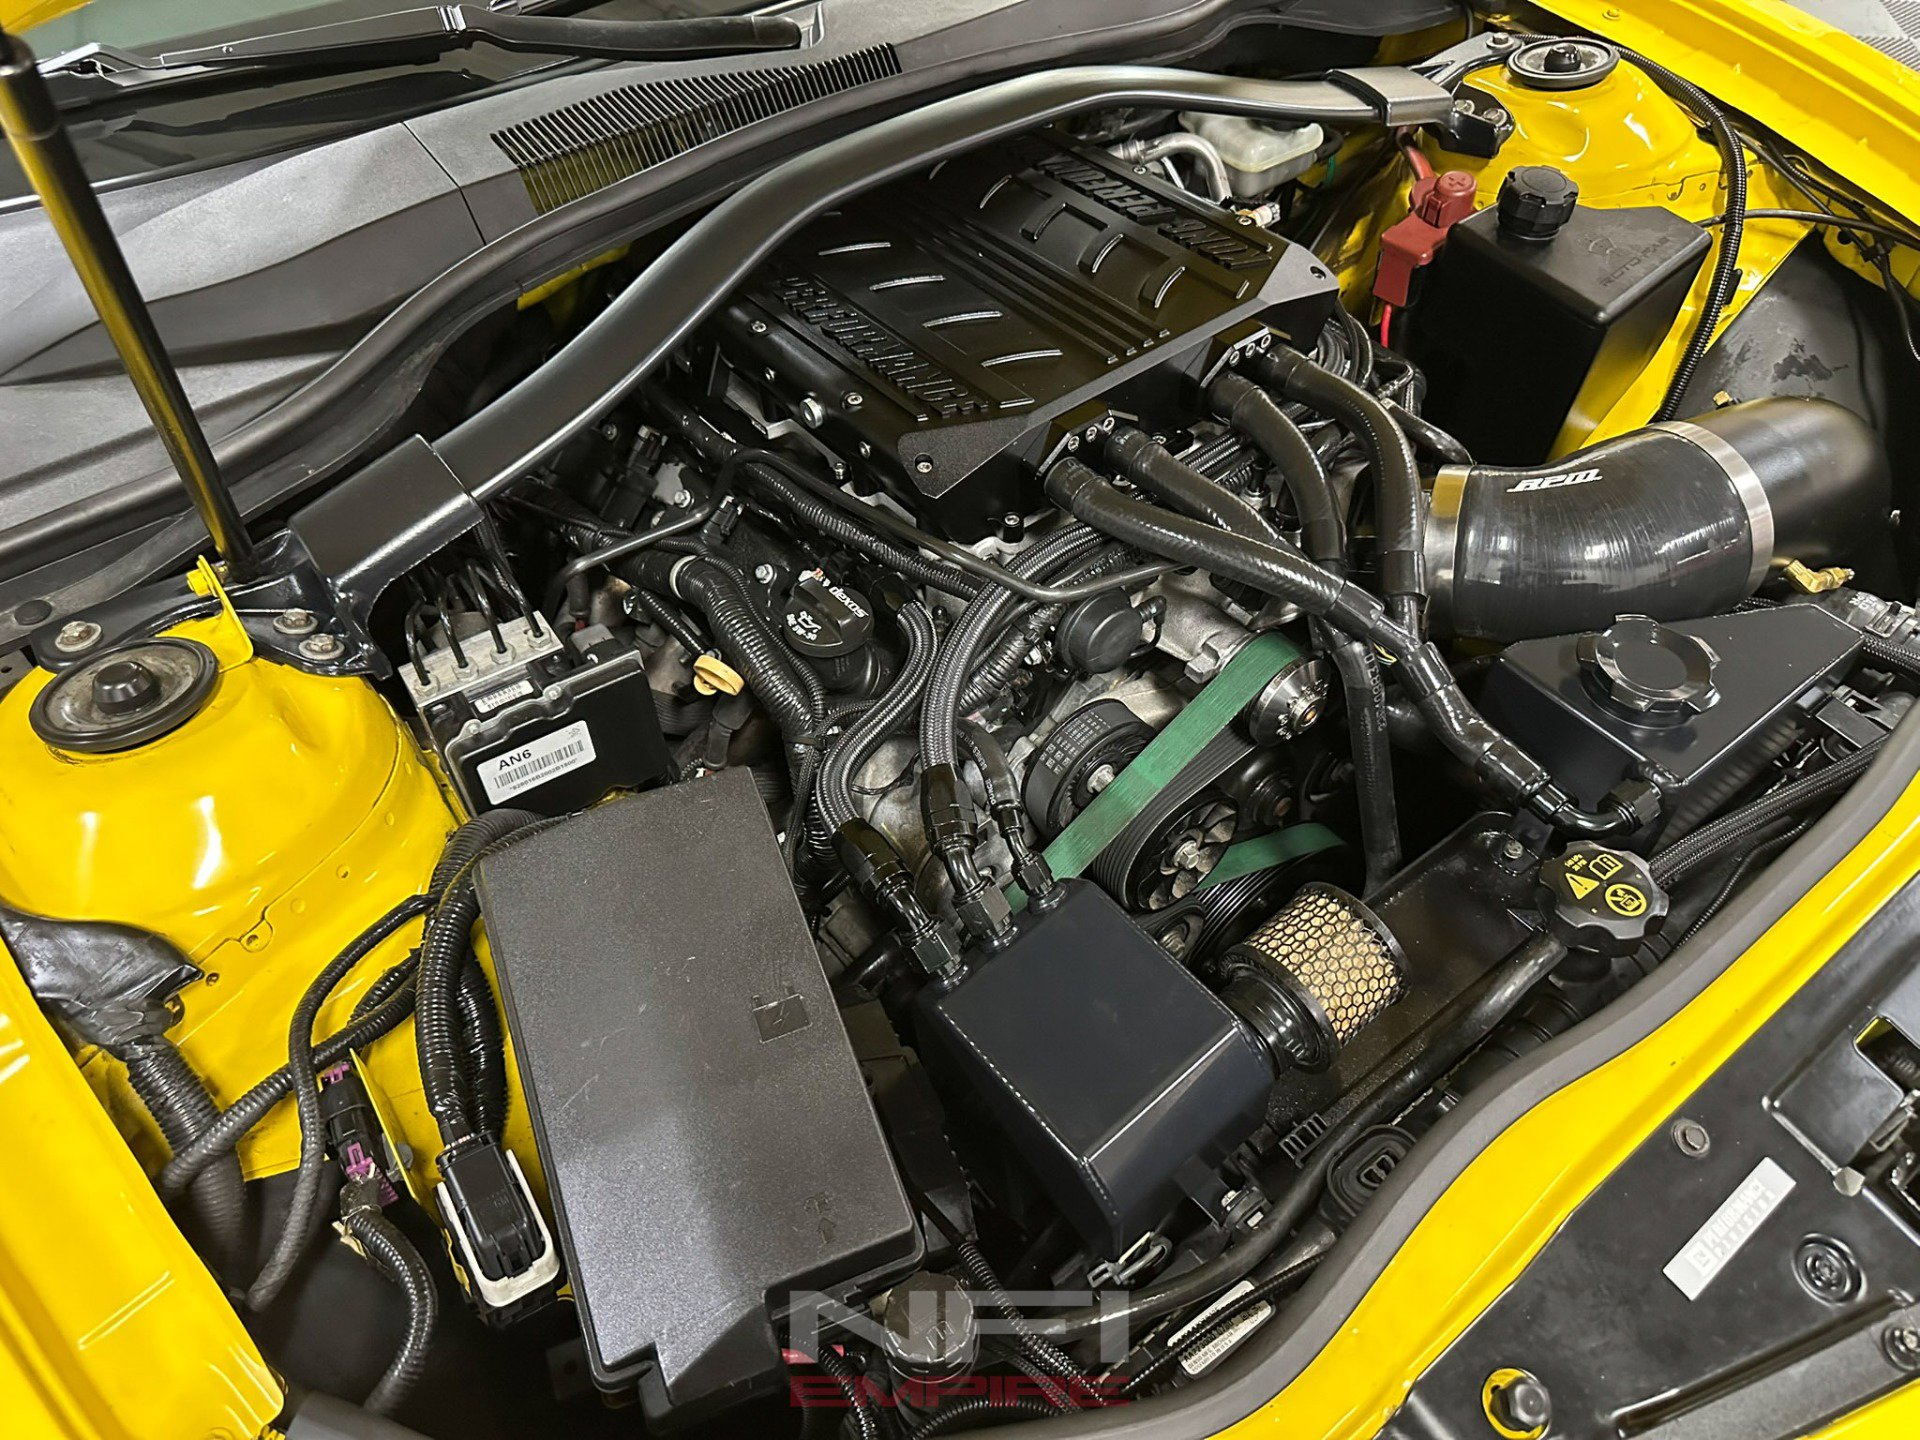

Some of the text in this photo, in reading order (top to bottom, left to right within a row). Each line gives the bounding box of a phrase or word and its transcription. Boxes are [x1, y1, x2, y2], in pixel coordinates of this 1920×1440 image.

[1157, 218, 1273, 270] KONG
[828, 585, 870, 618] dexos
[498, 749, 532, 772] AN6
